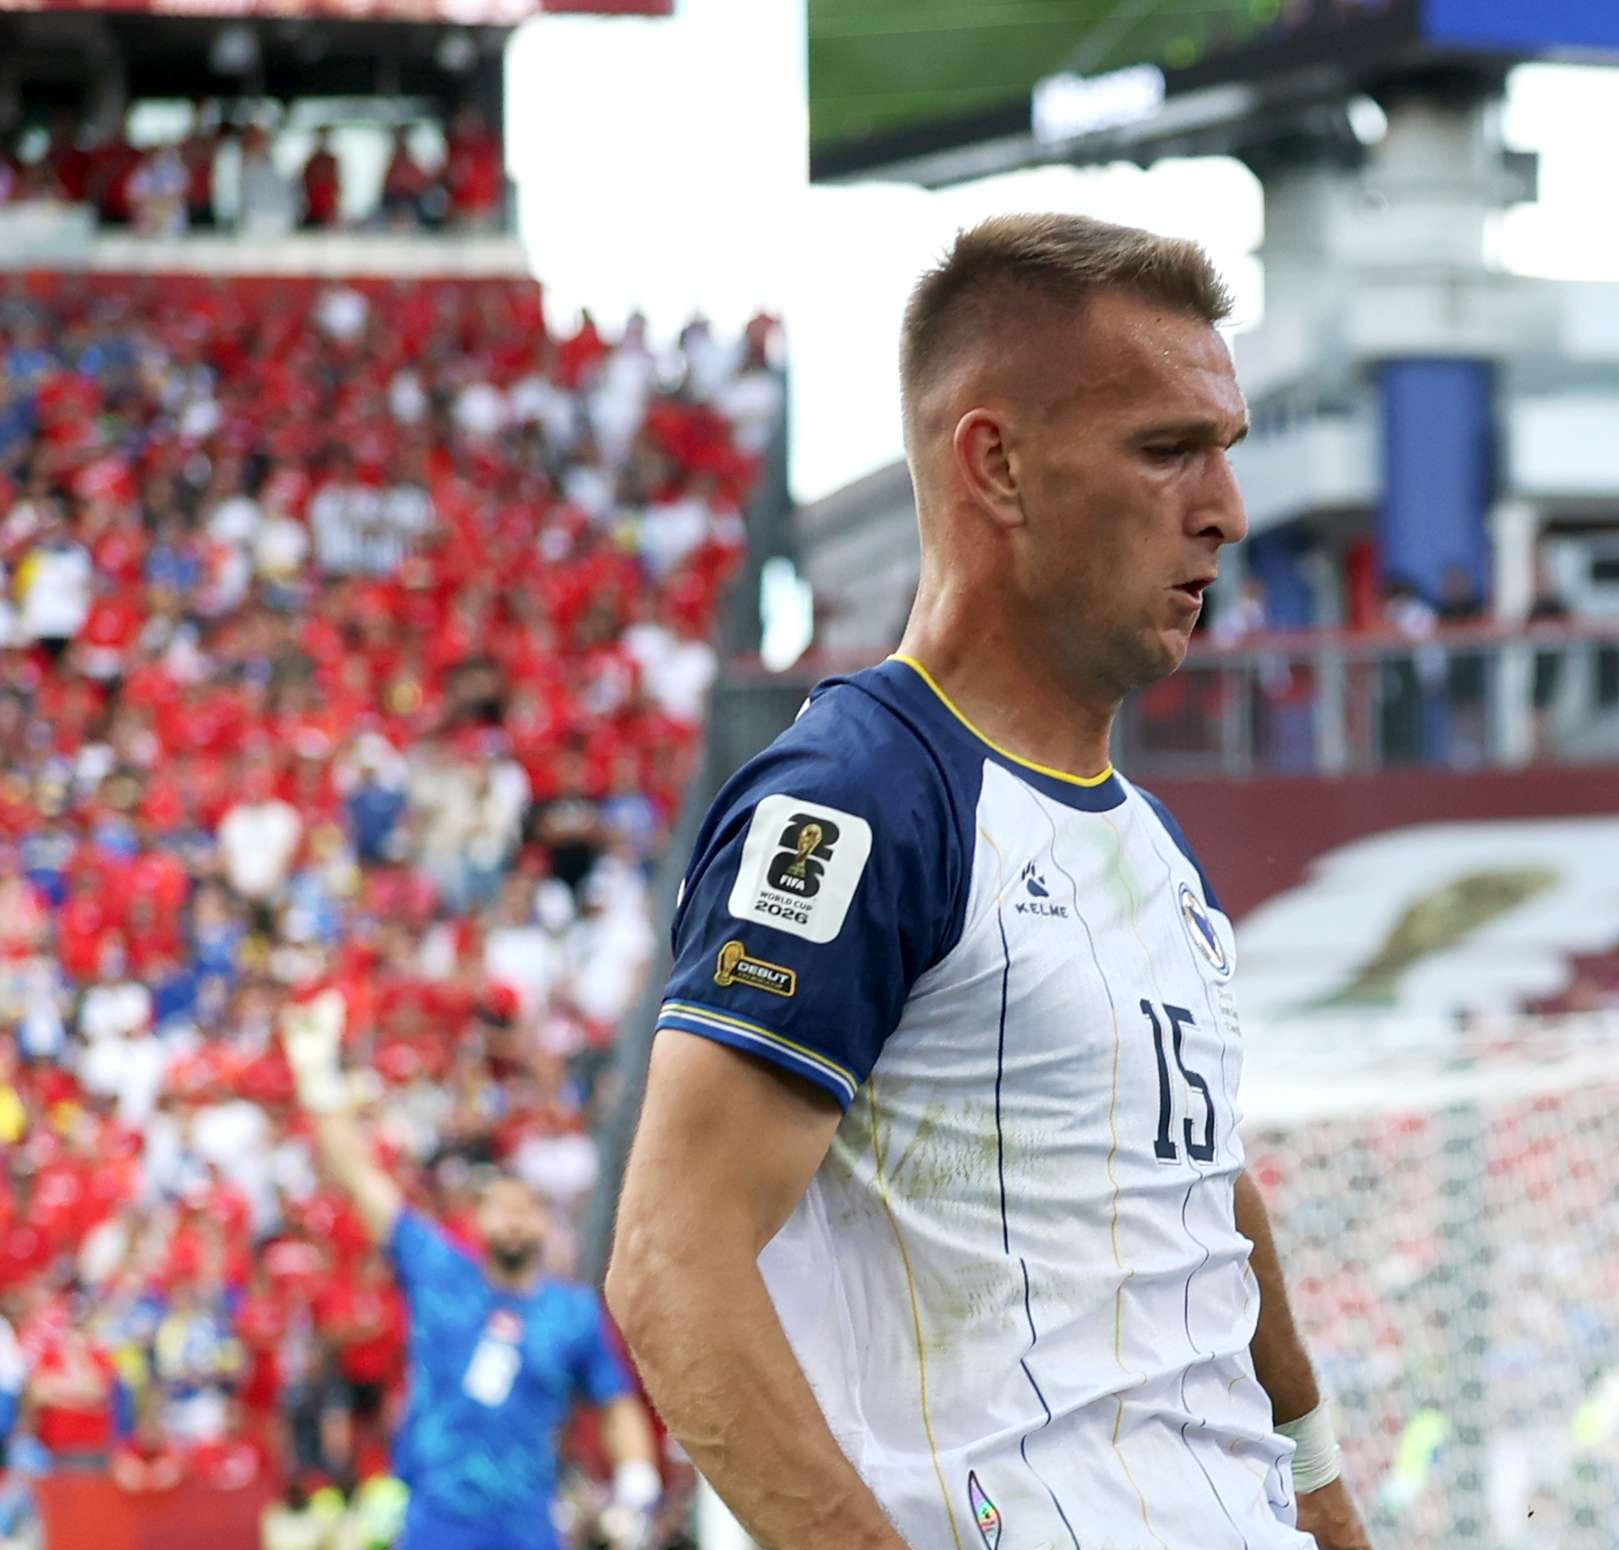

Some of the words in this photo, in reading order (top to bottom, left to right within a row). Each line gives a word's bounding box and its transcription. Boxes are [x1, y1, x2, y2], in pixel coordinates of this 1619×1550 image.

[779, 873, 806, 891] FIFA
[760, 890, 793, 906] WORLD
[793, 899, 814, 912] CUP
[1015, 902, 1070, 919] KELME
[754, 900, 809, 925] 2026
[737, 961, 790, 984] DEBUT
[1139, 998, 1216, 1163] 15
